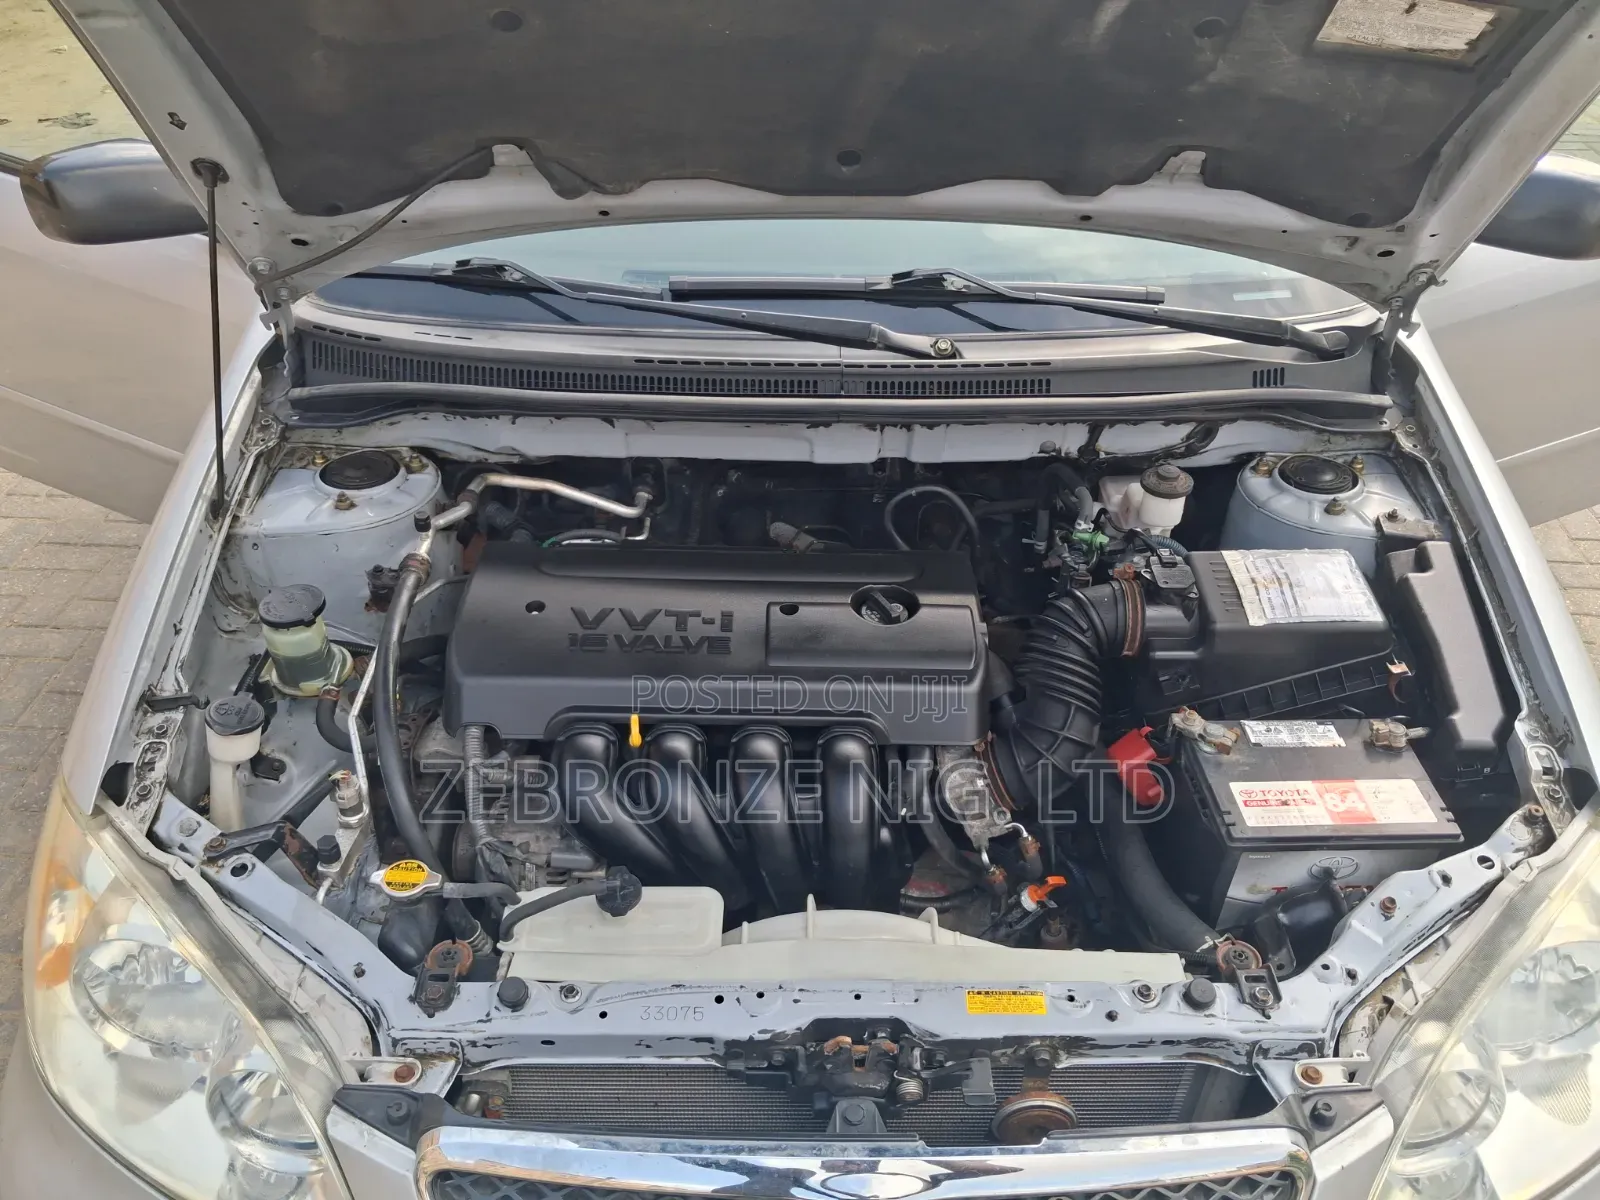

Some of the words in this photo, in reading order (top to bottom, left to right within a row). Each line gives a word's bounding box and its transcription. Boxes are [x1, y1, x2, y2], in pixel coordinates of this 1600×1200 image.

[1346, 33, 1385, 43] CATALYST
[613, 634, 732, 654] VALVE
[1259, 788, 1311, 797] TOYOTA
[1323, 792, 1367, 812] 84
[640, 1005, 704, 1021] 33075
